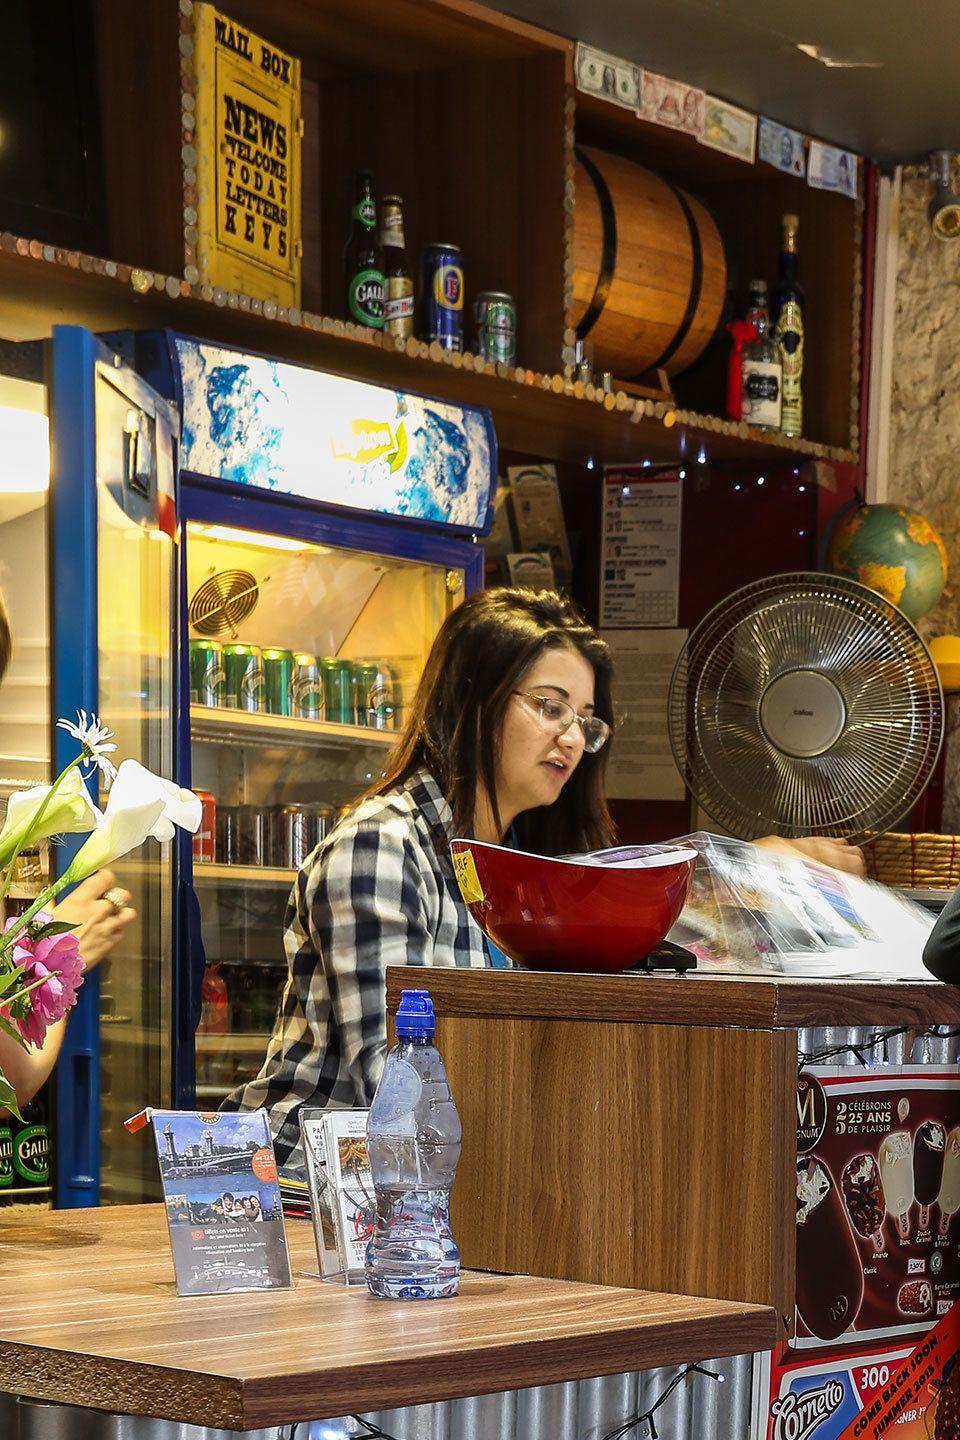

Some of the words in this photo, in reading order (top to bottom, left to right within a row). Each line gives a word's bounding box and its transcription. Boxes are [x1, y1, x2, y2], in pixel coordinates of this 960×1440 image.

[214, 17, 253, 62] MAIL
[261, 45, 290, 84] BOX
[224, 93, 288, 160] NEWS
[225, 133, 288, 184] WELCOME
[225, 157, 288, 205] TODAY
[225, 180, 288, 227] LETTERS
[225, 204, 288, 258] KEYS
[848, 1100, 892, 1111] CÉLÉBRONS
[848, 1113, 863, 1124] 25
[866, 1111, 892, 1123] ANS
[848, 1125, 858, 1134] DE
[861, 1124, 891, 1133] PLAISIR
[797, 1128, 820, 1139] GNUM
[853, 1398, 882, 1437] COME
[882, 1366, 910, 1404] BACK
[910, 1334, 938, 1372] SOON
[861, 1365, 889, 1390] 300
[873, 1388, 913, 1439] SUMMER
